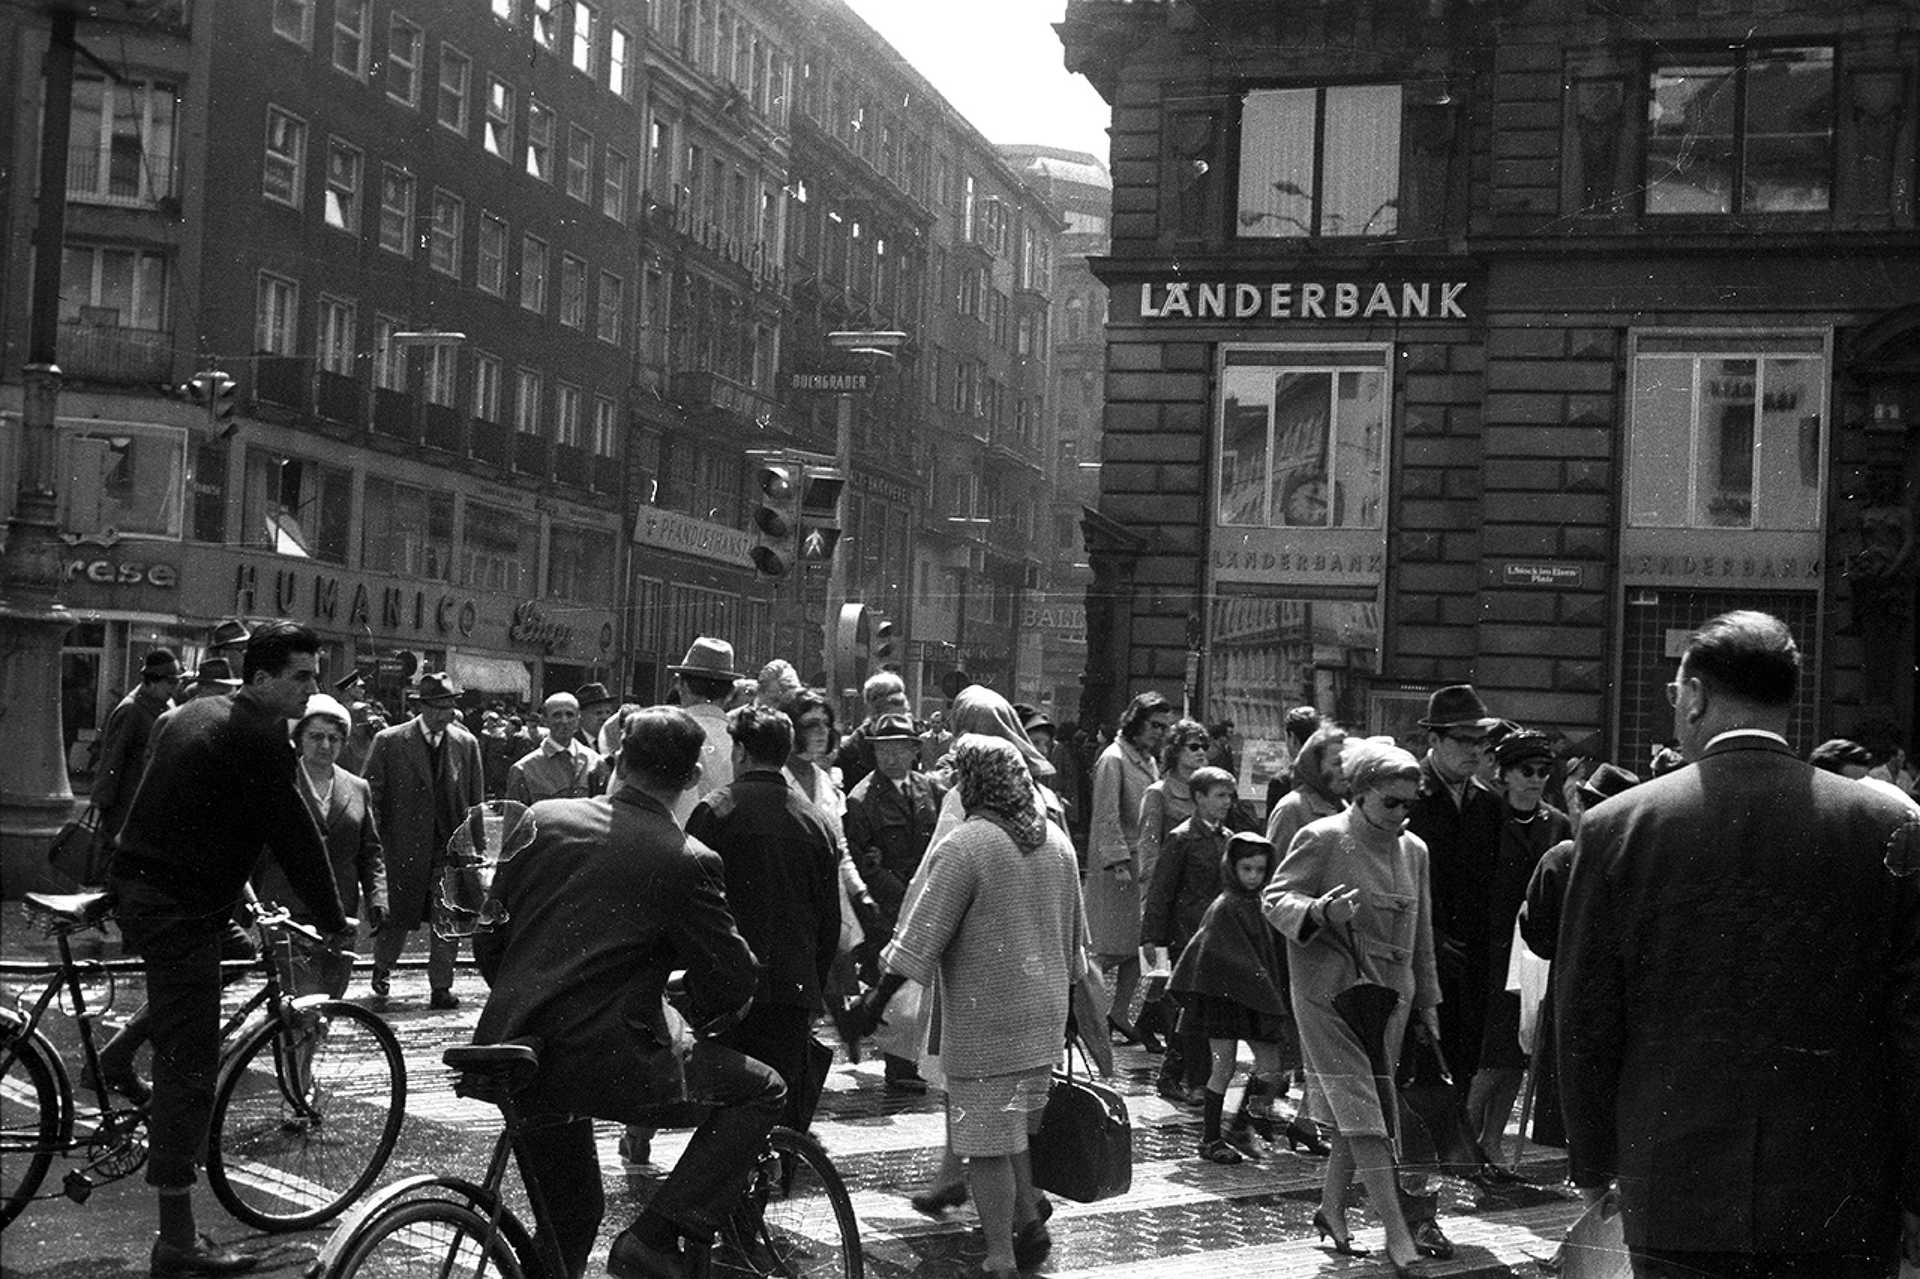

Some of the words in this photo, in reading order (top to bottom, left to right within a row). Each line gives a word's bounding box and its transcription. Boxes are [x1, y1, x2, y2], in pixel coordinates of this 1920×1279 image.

[1140, 282, 1468, 318] LÄNDERBANK
[1214, 551, 1383, 573] LÄNDERBANK
[1022, 607, 1087, 629] BALL
